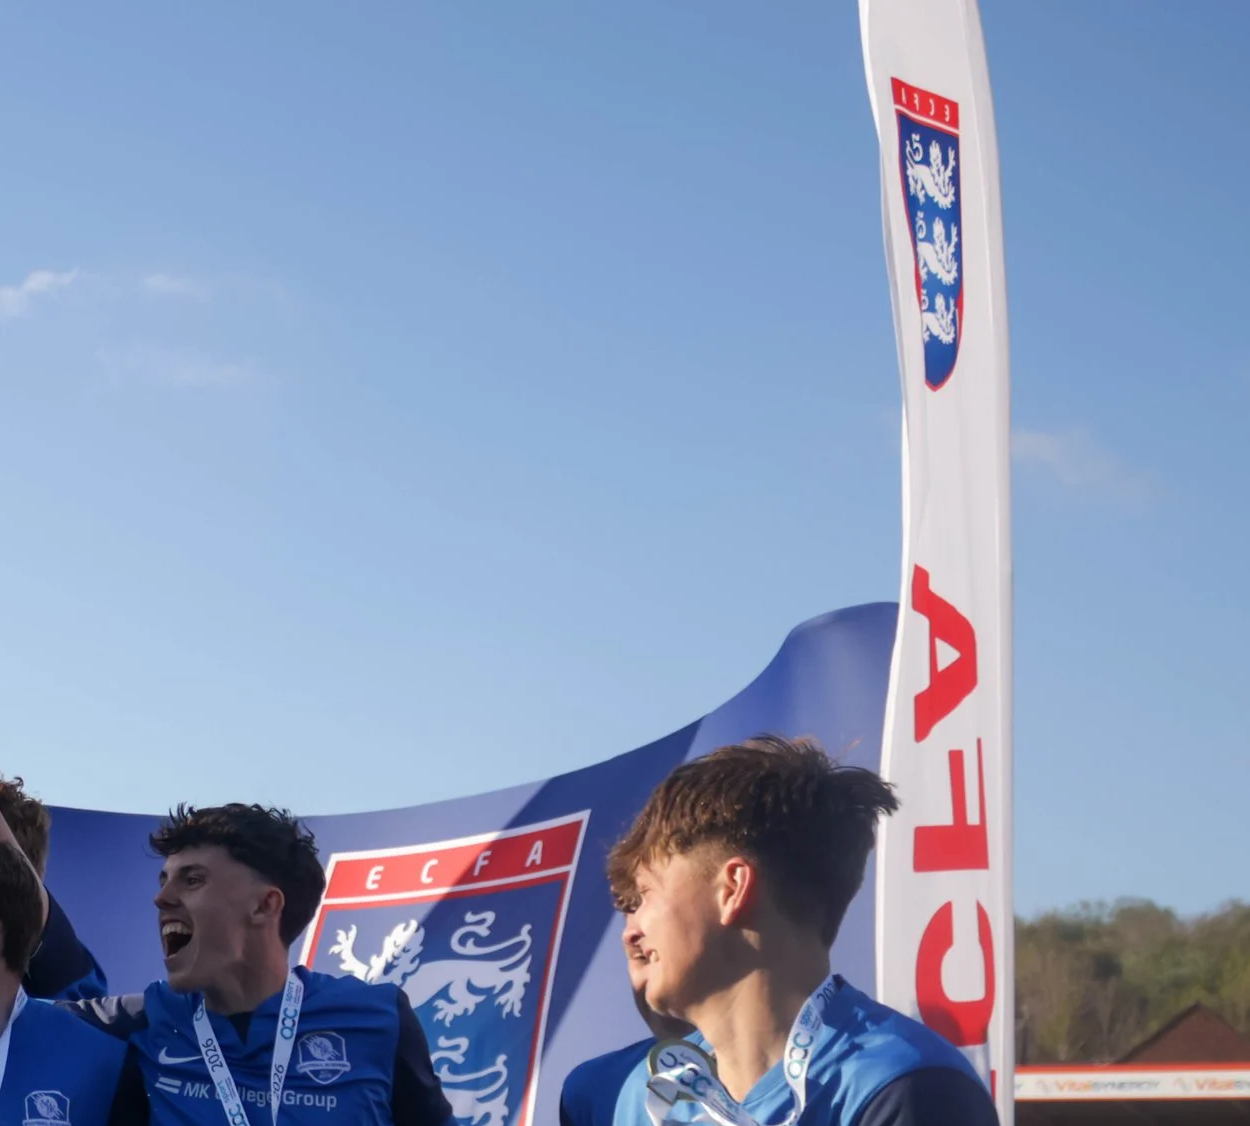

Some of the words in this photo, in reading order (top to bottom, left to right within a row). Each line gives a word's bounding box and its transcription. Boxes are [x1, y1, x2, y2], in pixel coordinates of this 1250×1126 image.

[365, 840, 542, 890] ECFA
[202, 1038, 224, 1073] 2026
[184, 1082, 210, 1099] MK
[283, 1090, 338, 1112] Group
